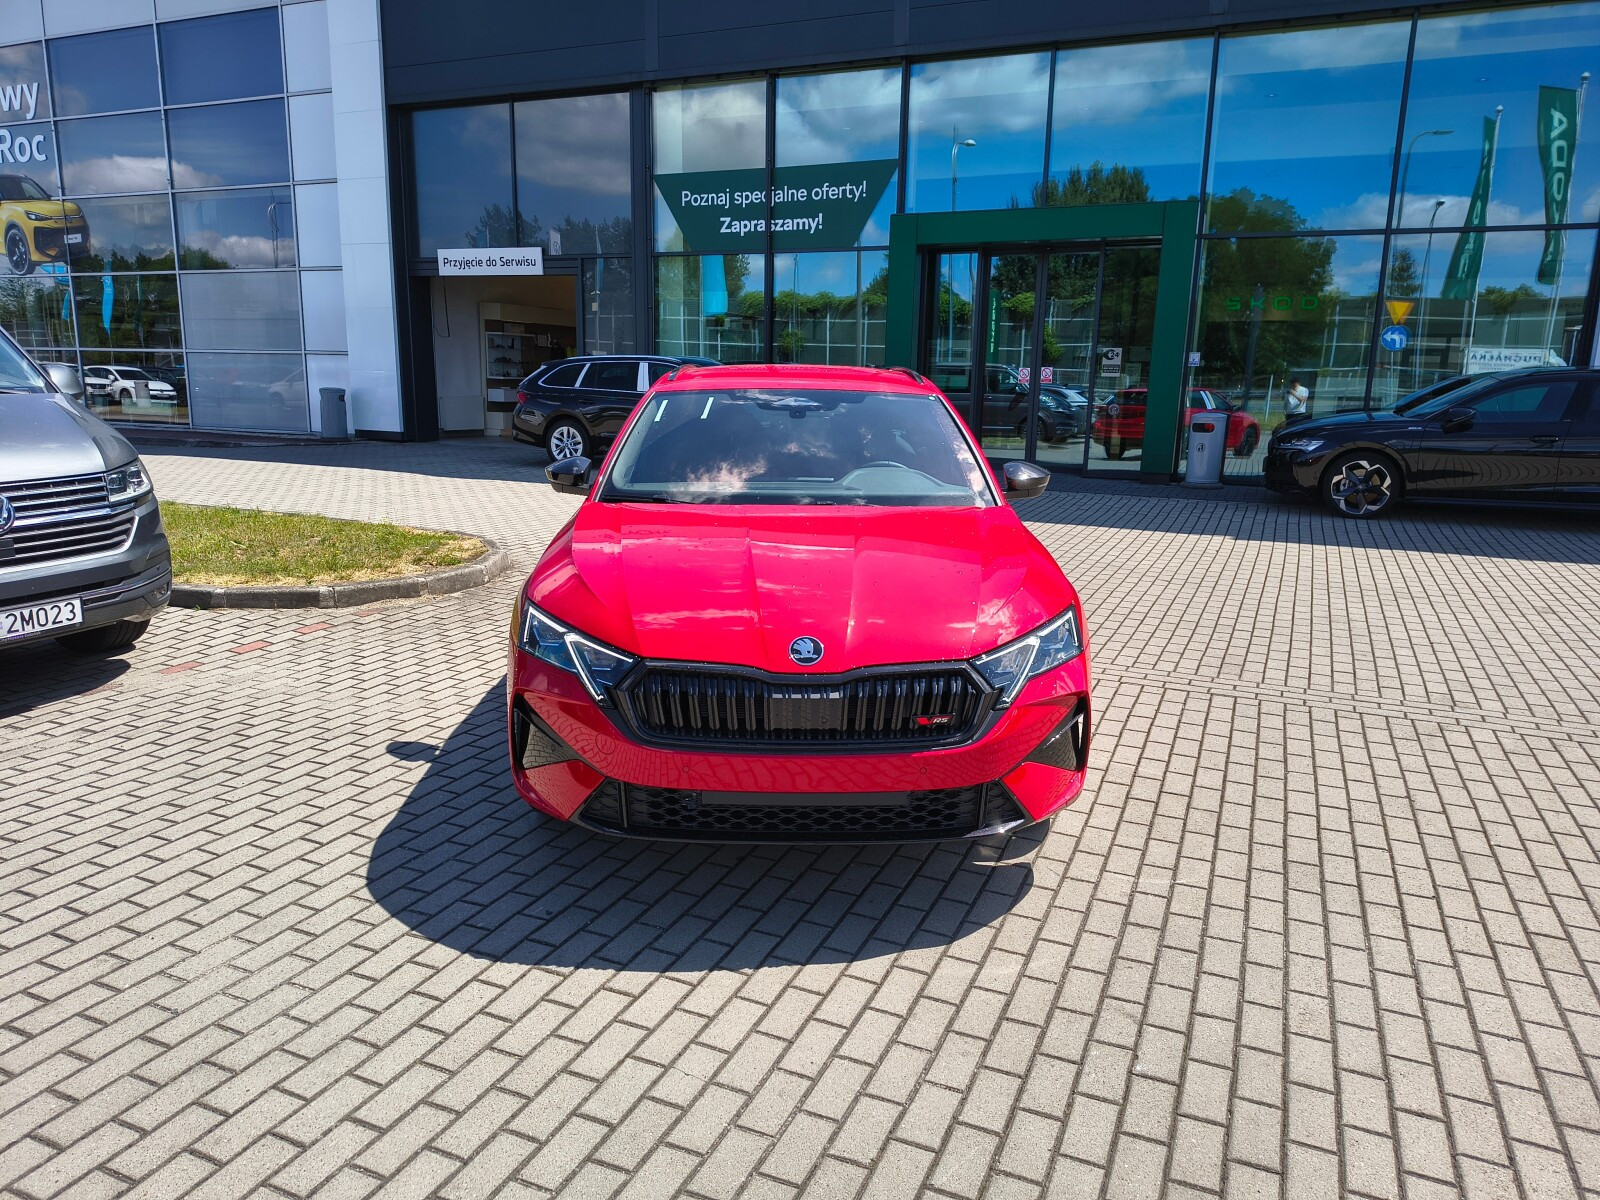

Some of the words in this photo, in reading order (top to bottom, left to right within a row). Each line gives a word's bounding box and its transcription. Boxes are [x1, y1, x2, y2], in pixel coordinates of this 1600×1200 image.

[681, 189, 730, 208] Poznaj
[811, 180, 867, 202] oferty!
[442, 257, 484, 270] Przyjęcie
[485, 256, 497, 267] do
[499, 255, 537, 267] Serwisu
